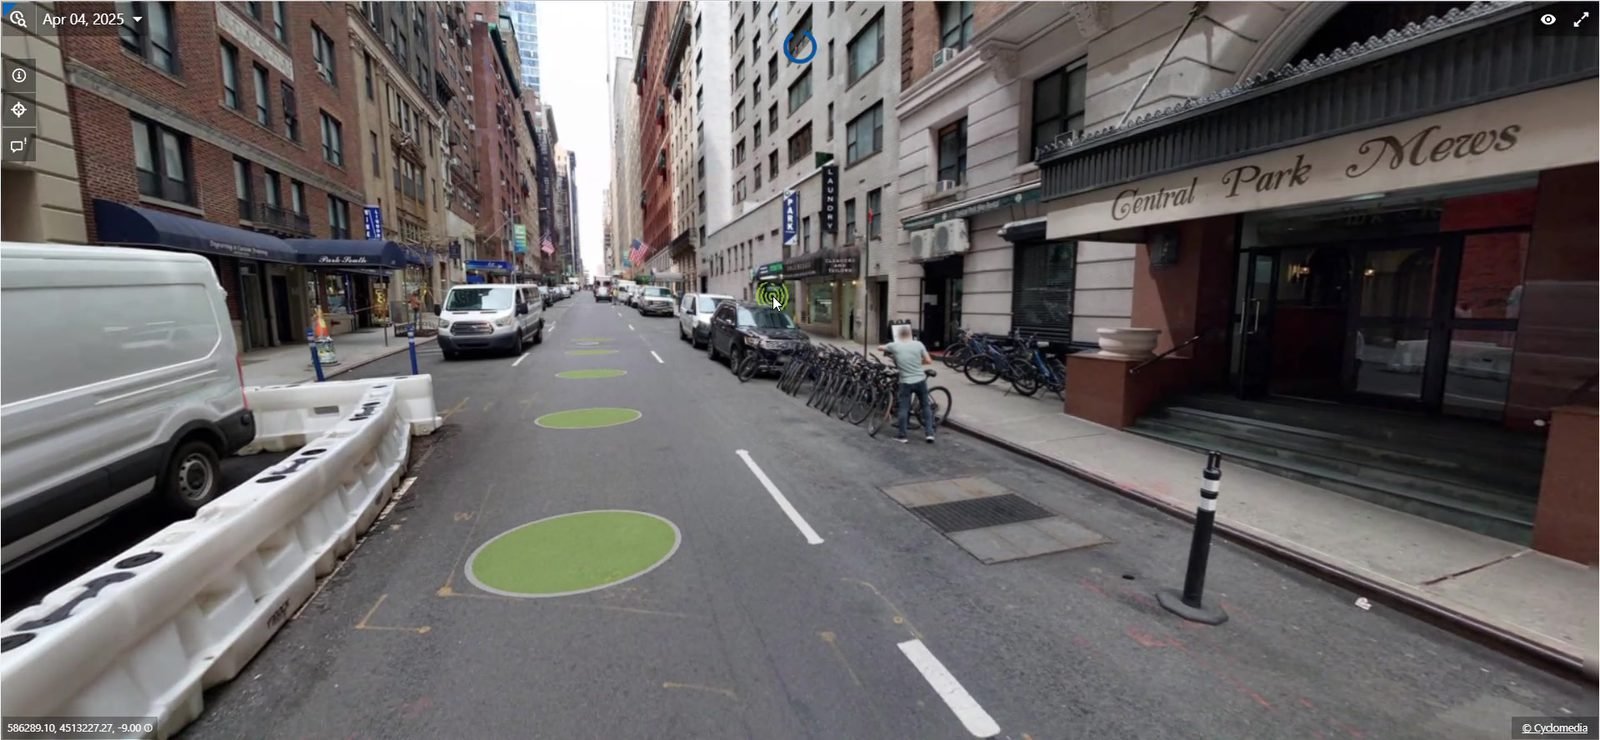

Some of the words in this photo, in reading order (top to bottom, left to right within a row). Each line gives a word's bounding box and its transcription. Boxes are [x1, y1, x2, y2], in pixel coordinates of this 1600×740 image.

[1111, 176, 1198, 221] Central
[1222, 154, 1313, 199] Park
[1345, 123, 1521, 179] Mews
[786, 198, 794, 231] PARK
[826, 168, 834, 229] LAUNDRY
[318, 255, 340, 263] Park
[341, 255, 367, 263] South
